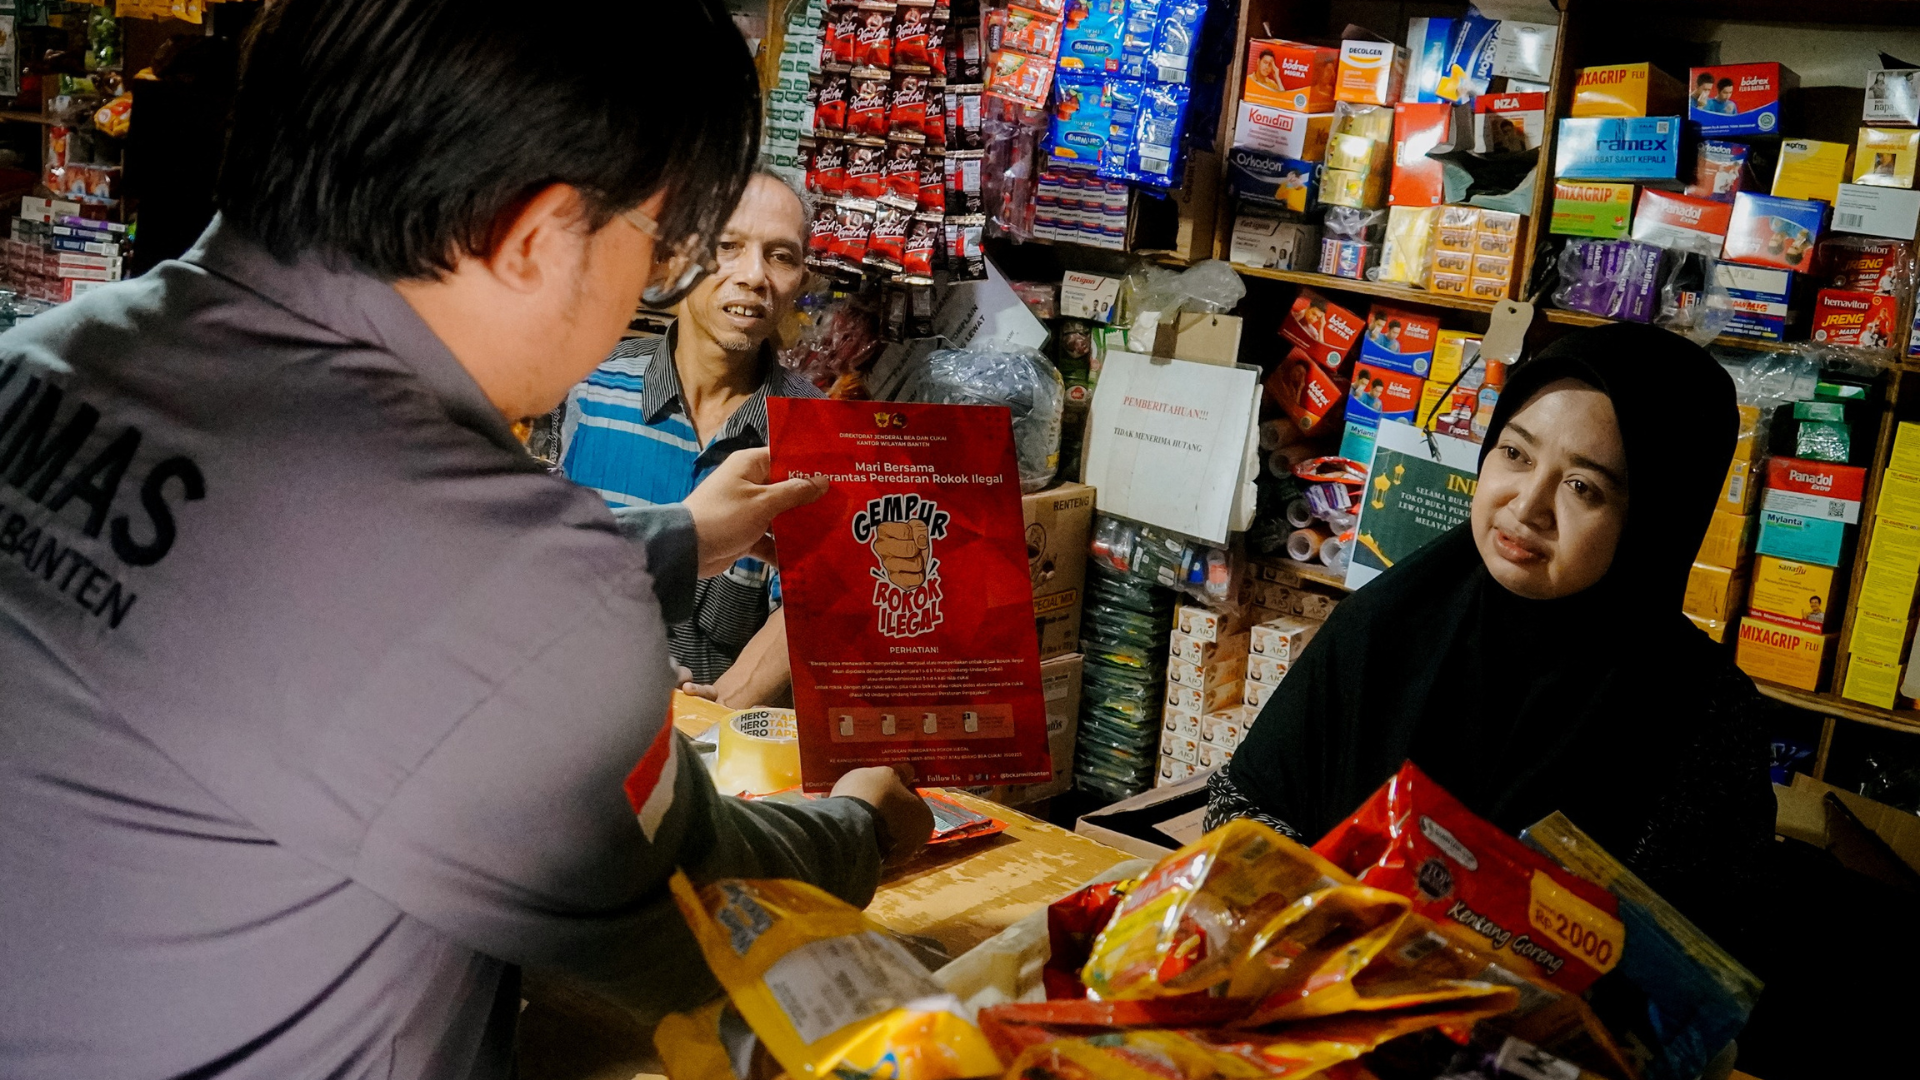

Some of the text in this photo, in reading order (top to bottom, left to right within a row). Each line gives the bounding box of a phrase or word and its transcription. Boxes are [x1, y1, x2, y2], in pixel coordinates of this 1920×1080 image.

[1349, 47, 1383, 56] DECOLGEN
[1632, 70, 1645, 79] FLU
[1249, 108, 1293, 130] Konidin
[1596, 139, 1667, 150] ramex
[1236, 153, 1282, 172] Oskadon
[1638, 155, 1666, 163] KEPALA
[1556, 186, 1613, 203] MIXAGRIP
[1661, 201, 1702, 218] Panadol
[1481, 241, 1509, 253] GPU
[1438, 258, 1465, 270] GPU
[1478, 263, 1506, 275] GPU
[1068, 274, 1097, 285] fatigon
[1436, 280, 1462, 292] GPU
[1475, 285, 1503, 297] GPU
[1824, 296, 1870, 310] hemaviton
[1821, 314, 1864, 326] JRENG
[1123, 396, 1209, 420] PEMBERITAHUAN!!!
[1114, 427, 1202, 452] TIDAK MENERIMA HUTANG
[855, 462, 935, 473] Mari Bersama
[788, 471, 1003, 485] Kita Berantas Peredaran Rokok Ilegal
[1789, 469, 1833, 486] Panadol
[1416, 487, 1446, 501] SELAMA
[1054, 496, 1090, 511] RENTENG
[1401, 492, 1471, 518] TOKO BUKA PUKU
[853, 494, 949, 542] GEMPUR
[1398, 501, 1424, 515] LEWAT
[1427, 510, 1447, 522] DARI
[1767, 513, 1803, 526] Mylanta
[0, 513, 138, 629] BANTEN
[1778, 564, 1807, 576] sanaflu
[875, 577, 942, 612] ROKOK
[1034, 597, 1059, 611] PECIAL
[880, 602, 941, 636] ILEGAL
[1740, 624, 1819, 652] MIXAGRIP FLU
[1447, 900, 1563, 975] Kentang Goreng
[1556, 913, 1613, 966] 2000
